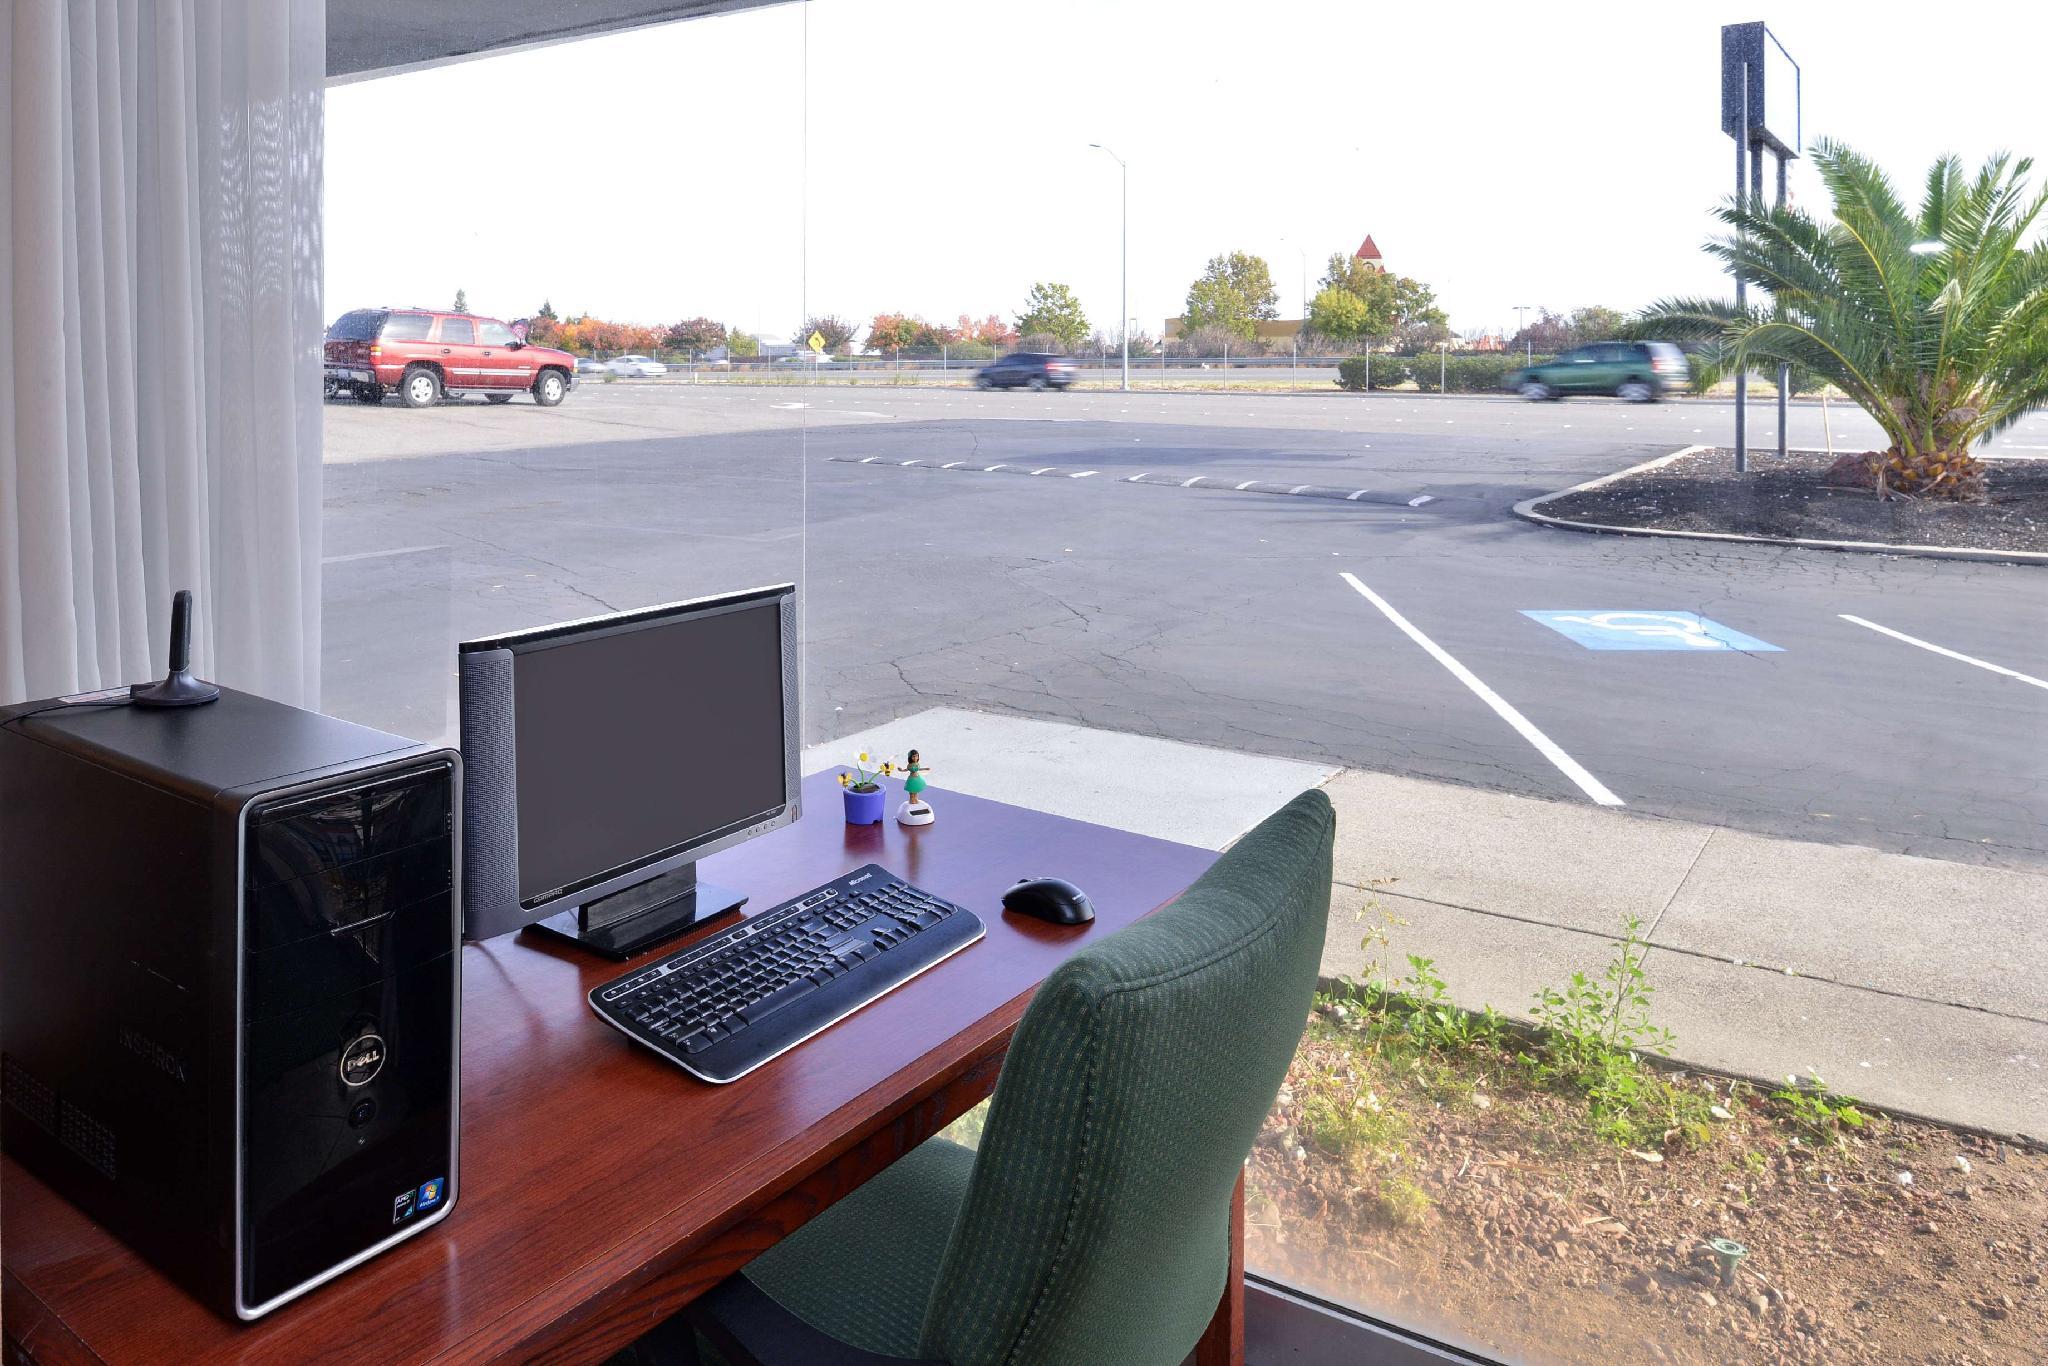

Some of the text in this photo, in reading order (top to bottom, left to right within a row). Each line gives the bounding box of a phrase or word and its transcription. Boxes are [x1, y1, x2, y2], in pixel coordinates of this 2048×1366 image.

[848, 872, 873, 886] Microsoft
[533, 888, 563, 904] COMPAQ
[347, 1050, 380, 1072] DELL
